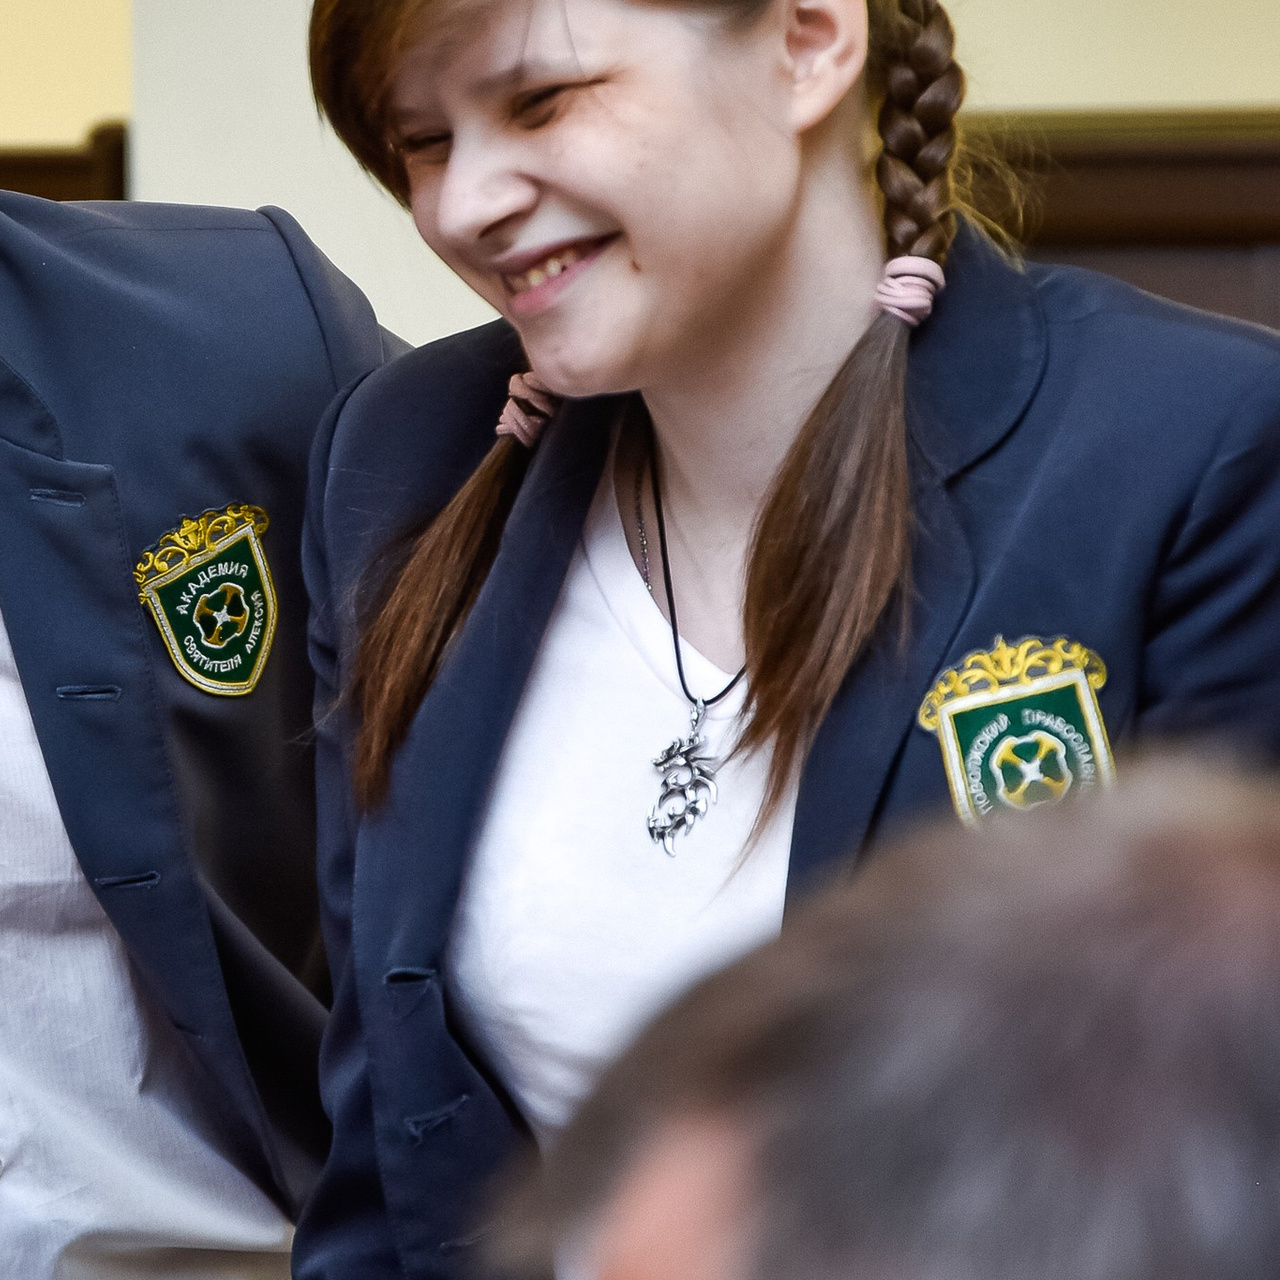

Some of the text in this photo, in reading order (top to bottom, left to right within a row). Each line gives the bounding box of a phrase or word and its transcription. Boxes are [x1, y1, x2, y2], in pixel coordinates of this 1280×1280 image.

[176, 561, 249, 615] АКАДЕМИЯ
[183, 590, 265, 673] СВЯТИТЕЛЯ АЛЕКСИЯ
